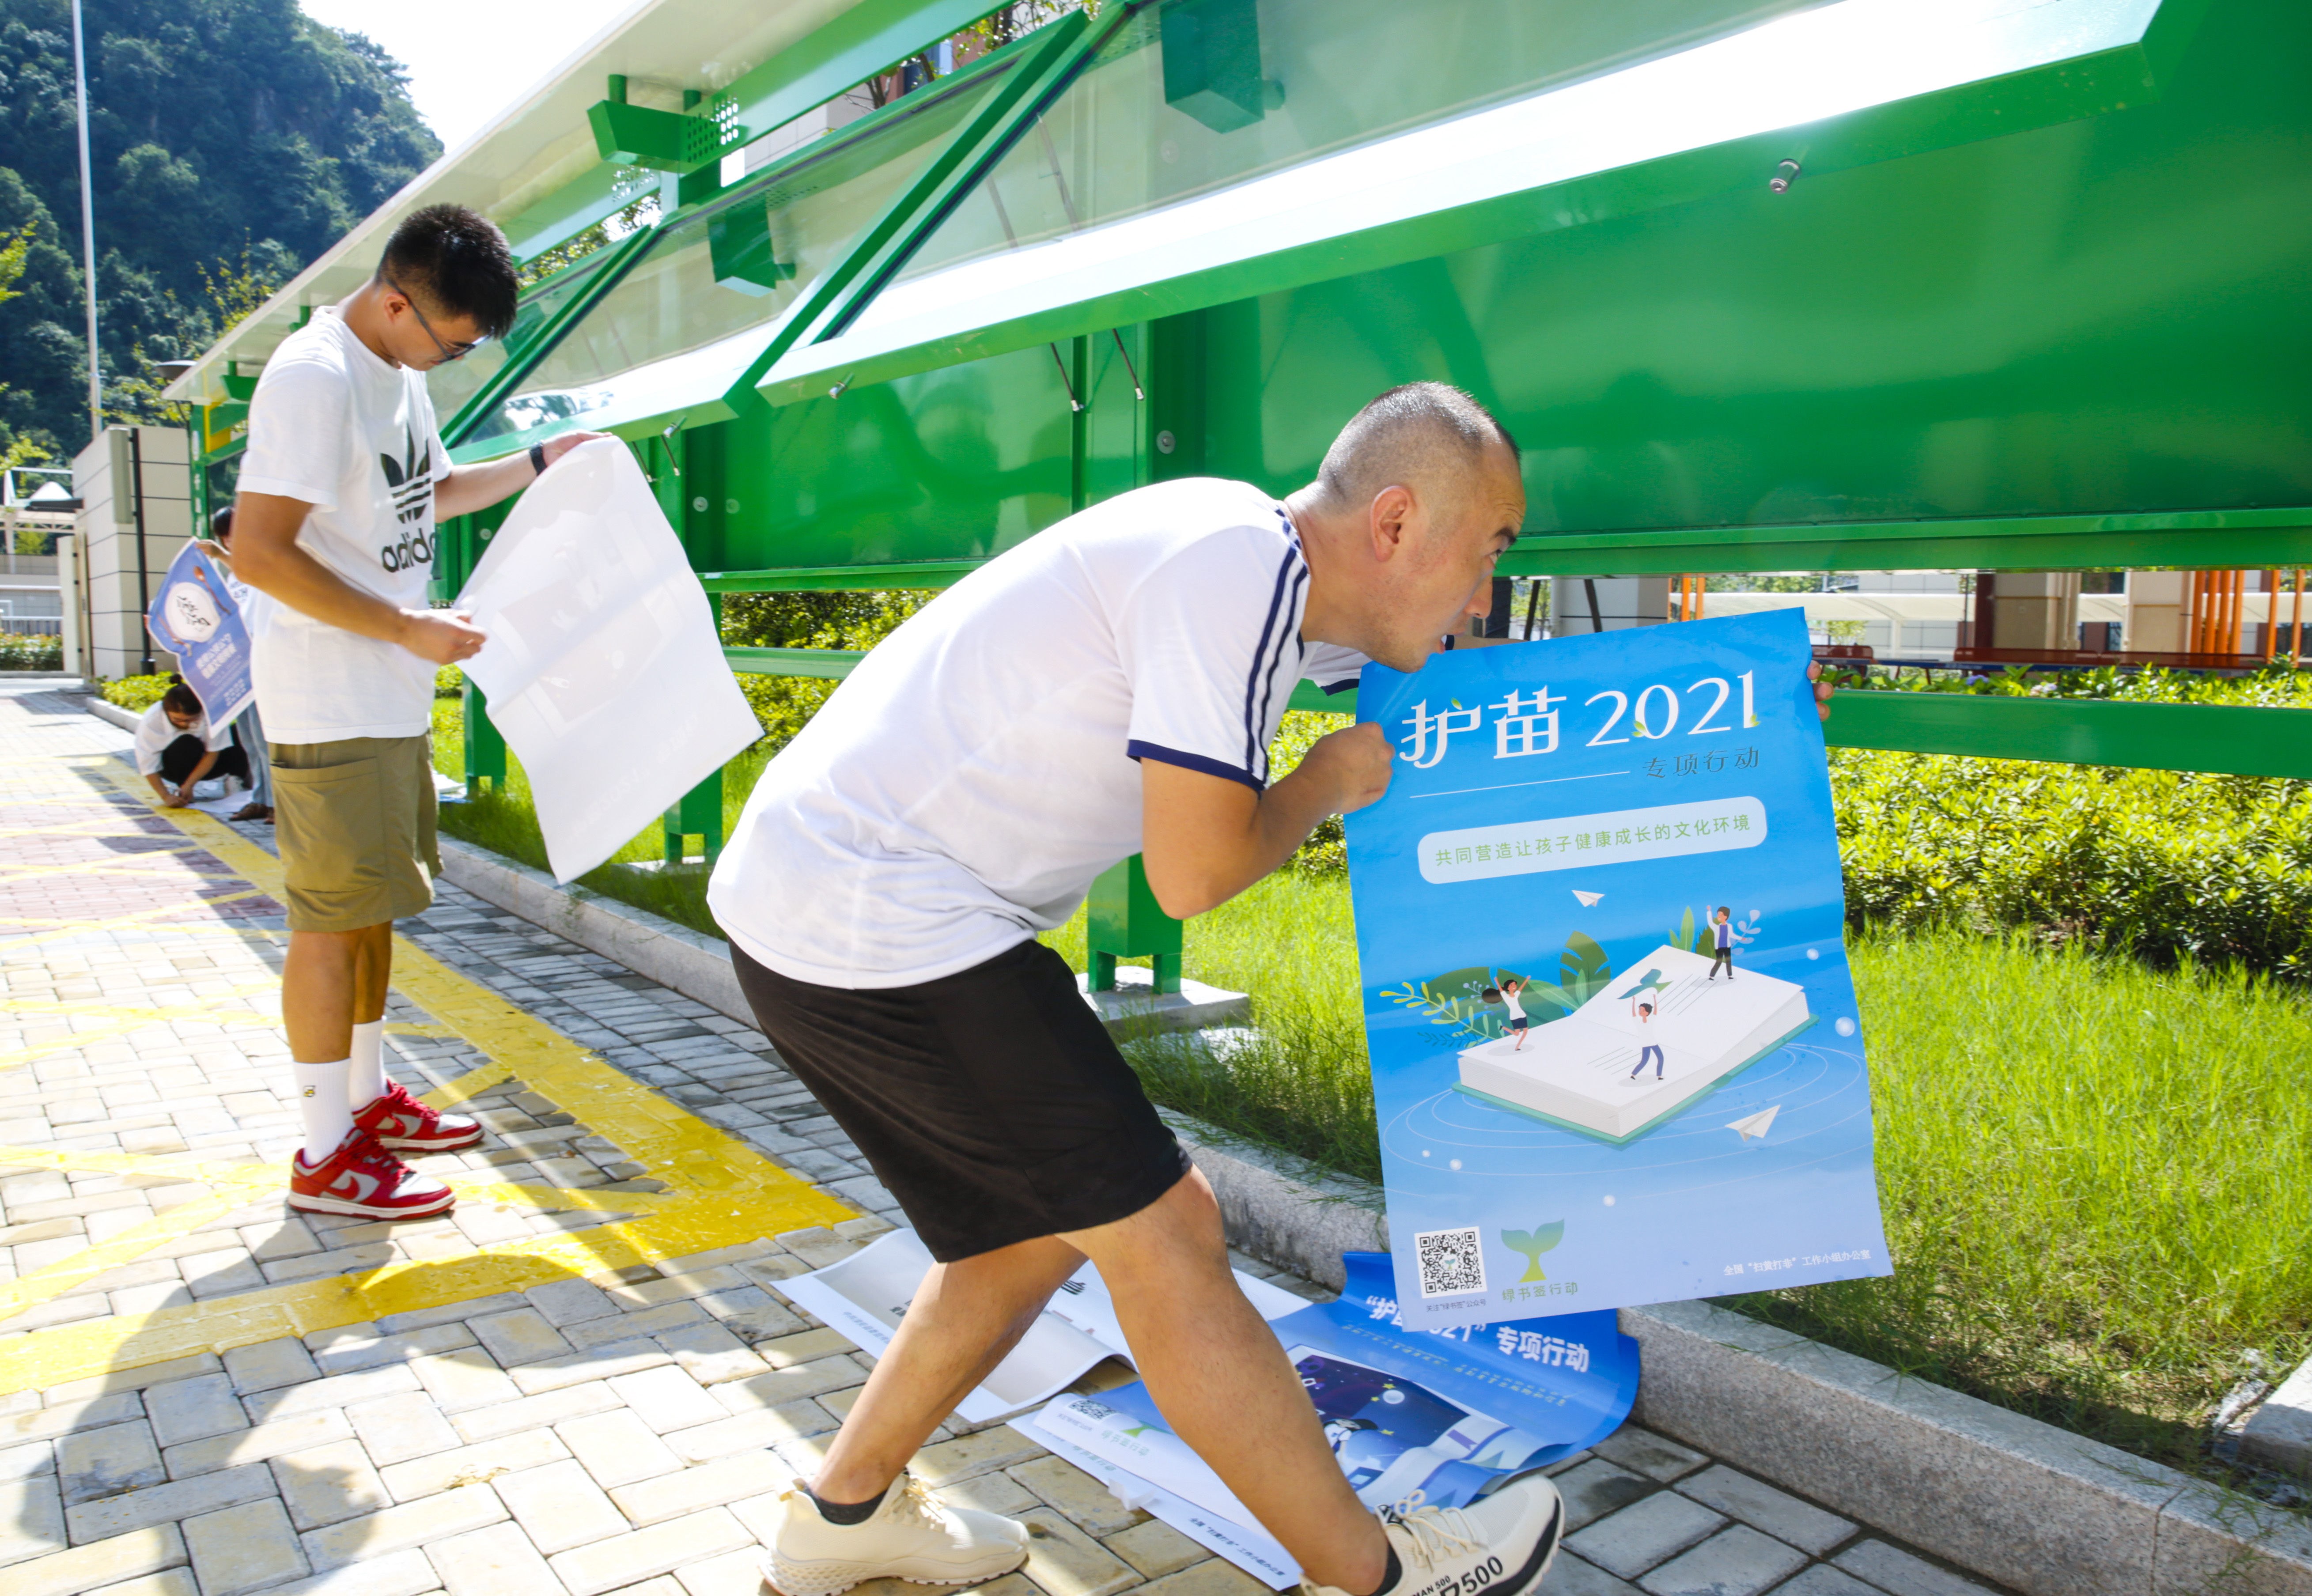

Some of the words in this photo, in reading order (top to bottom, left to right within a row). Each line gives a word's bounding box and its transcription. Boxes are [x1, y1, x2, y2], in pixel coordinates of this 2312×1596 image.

[1400, 685, 1567, 769] 护苗
[1585, 669, 1757, 747] 2021
[1642, 746, 1759, 779] 专项行动
[1435, 814, 1750, 866] 共同营造让孩子健康成长的文化环境
[1502, 1282, 1578, 1303] 绿书签行动
[1497, 1326, 1589, 1373] 专项行动
[1435, 1575, 1450, 1589] 500
